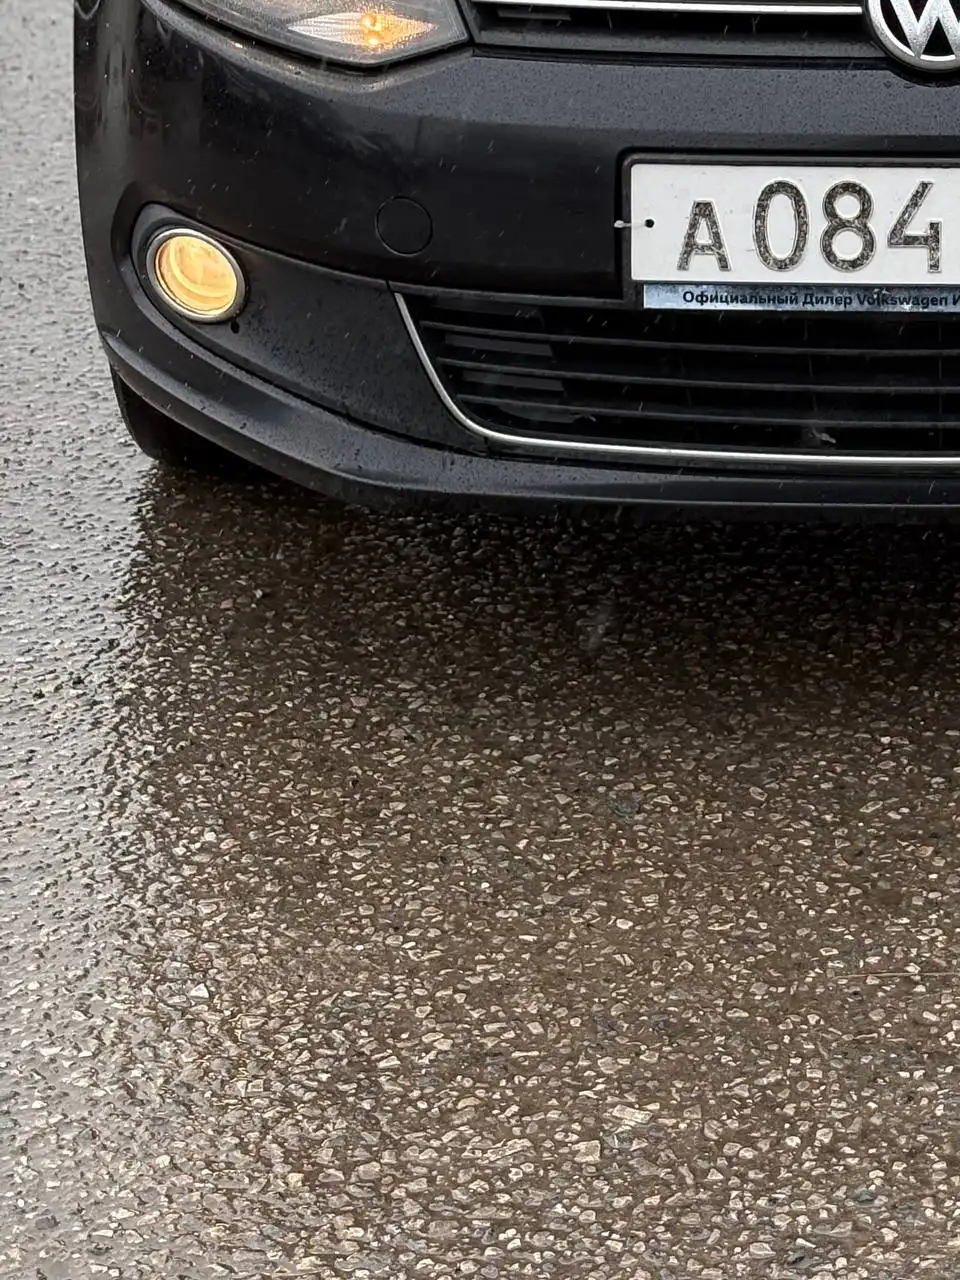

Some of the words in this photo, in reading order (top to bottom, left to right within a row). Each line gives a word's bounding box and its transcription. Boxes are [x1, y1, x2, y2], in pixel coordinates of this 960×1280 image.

[682, 290, 799, 306] Официальный
[802, 292, 853, 307] Дилер
[857, 292, 948, 308] Volkswagen
